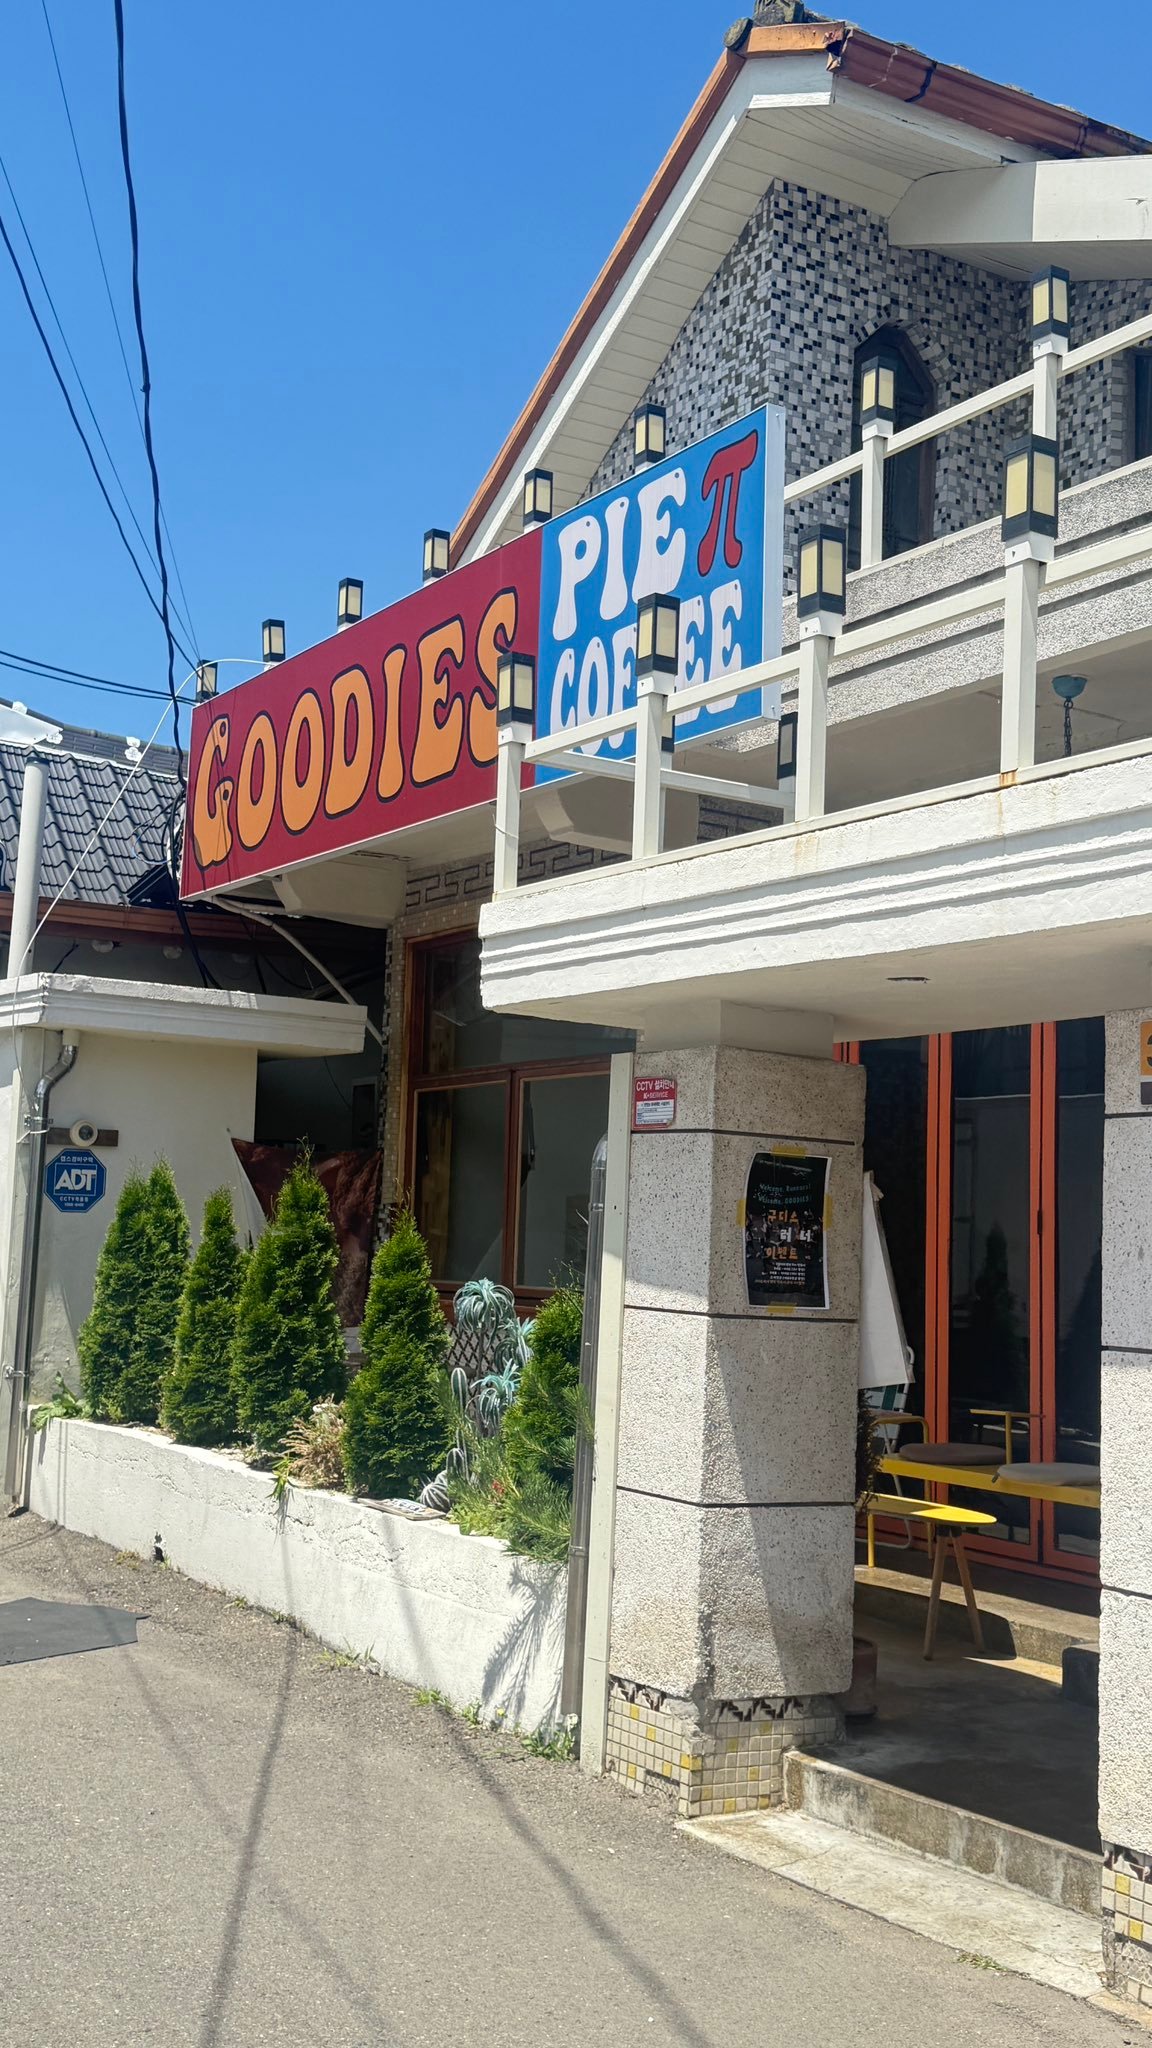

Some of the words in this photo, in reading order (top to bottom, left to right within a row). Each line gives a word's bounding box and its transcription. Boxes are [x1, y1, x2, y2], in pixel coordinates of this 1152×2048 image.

[553, 467, 686, 641] PIE
[193, 586, 517, 871] GOODIES
[549, 579, 742, 756] COFEE
[636, 1081, 653, 1091] CCTV
[55, 1168, 97, 1191] ADT
